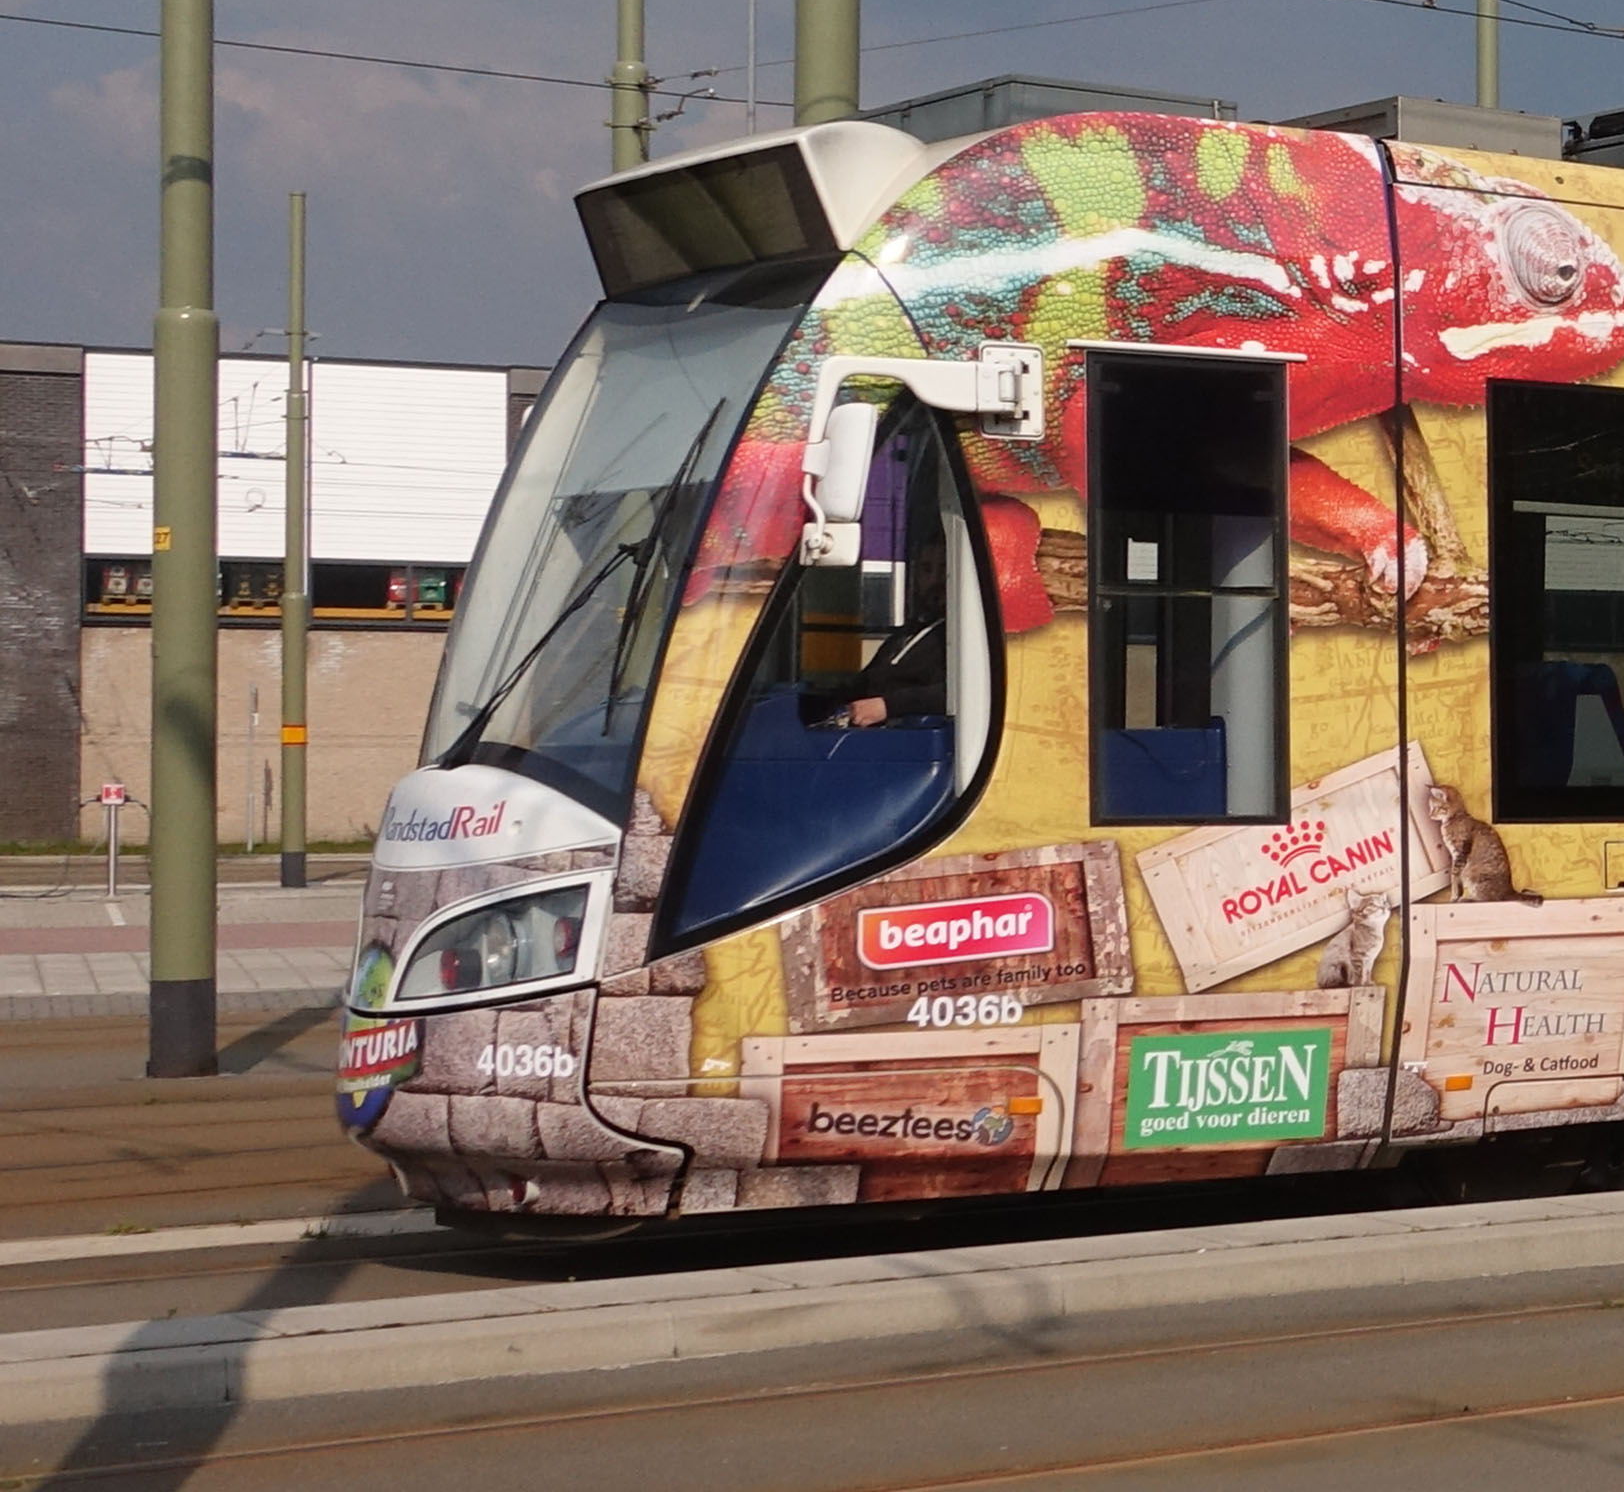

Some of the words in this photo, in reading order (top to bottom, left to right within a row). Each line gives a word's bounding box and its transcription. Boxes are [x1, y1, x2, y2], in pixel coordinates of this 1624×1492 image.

[384, 801, 506, 841] RandstadRail
[1222, 871, 1309, 925] ROYAL
[1309, 830, 1395, 884] CANIN
[879, 910, 1033, 949] beaphar
[830, 983, 912, 1003] Because
[917, 976, 956, 996] pets
[961, 972, 992, 988] are
[996, 962, 1052, 985] family
[1057, 962, 1086, 977] too
[1439, 962, 1583, 1004] NATURAL
[907, 994, 1023, 1028] 4036b
[1482, 1005, 1605, 1048] HEALTH
[475, 1043, 575, 1078] 4036b
[1143, 1043, 1318, 1113] TIJSSEN
[1482, 1058, 1520, 1076] Dog-
[1523, 1057, 1536, 1073] &
[1539, 1052, 1600, 1073] Catfood
[807, 1101, 973, 1143] beeztees
[1140, 1112, 1190, 1137] goed
[1196, 1109, 1242, 1129] voor
[1247, 1103, 1311, 1127] dieren
